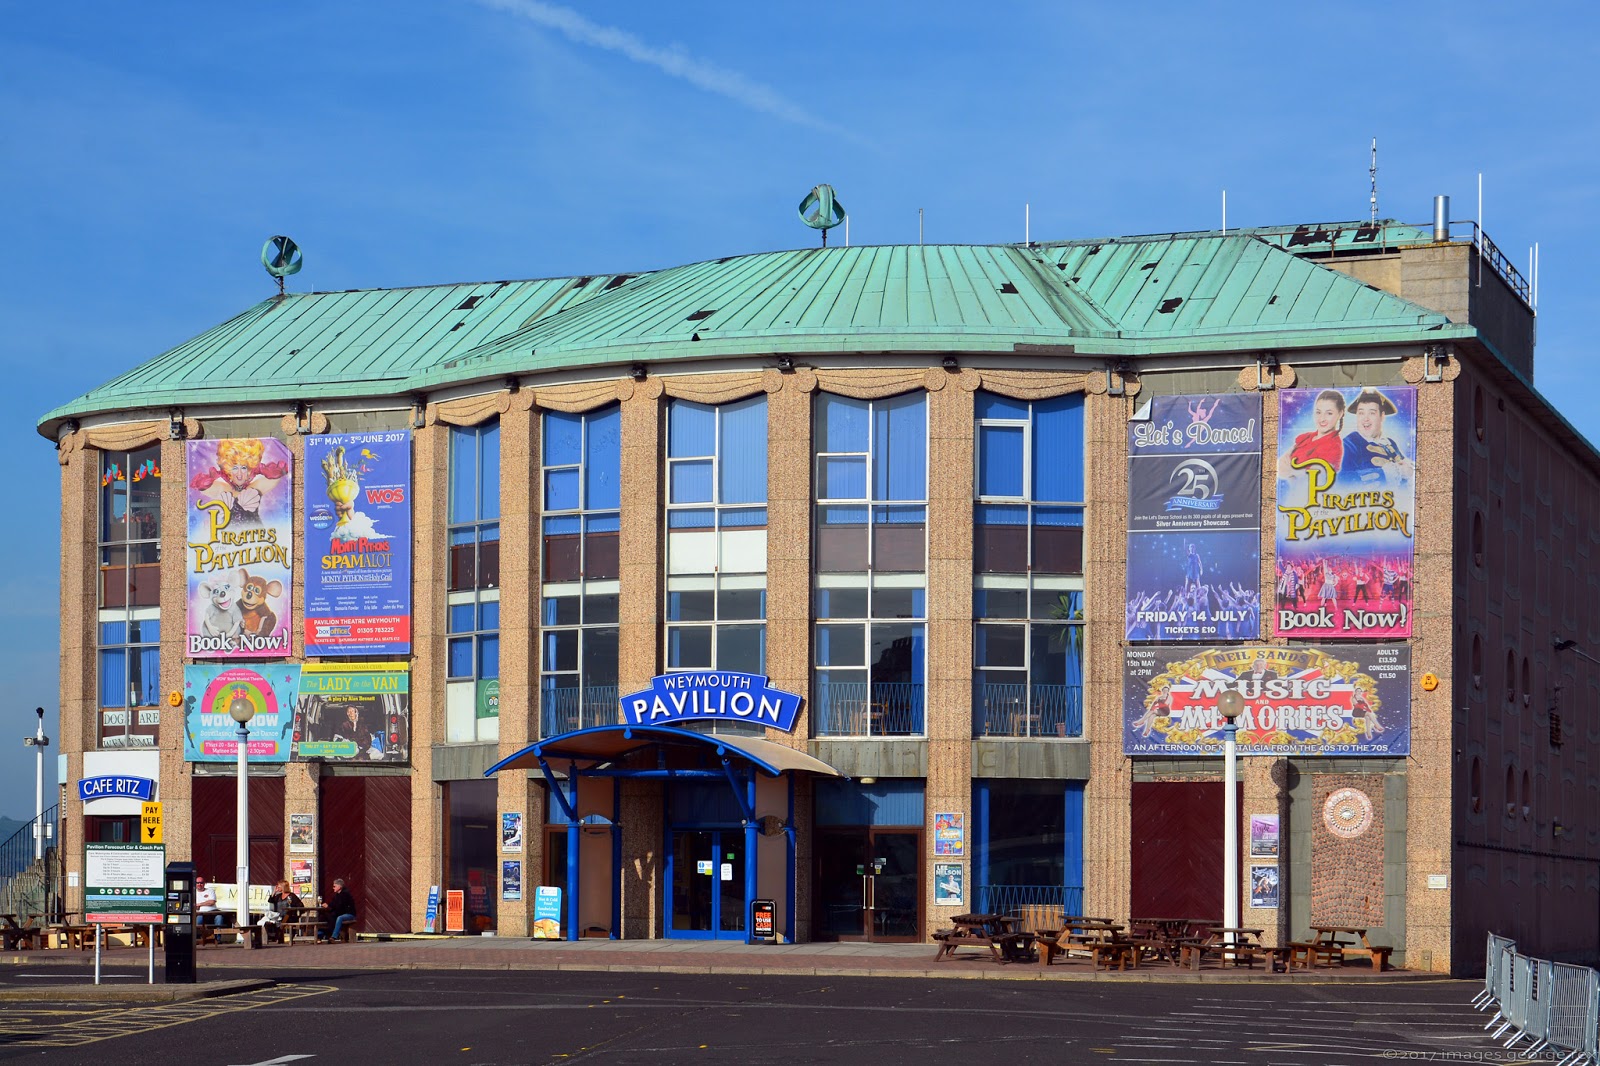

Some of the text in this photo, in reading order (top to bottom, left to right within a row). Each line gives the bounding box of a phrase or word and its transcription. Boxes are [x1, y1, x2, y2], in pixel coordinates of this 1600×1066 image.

[324, 436, 343, 445] MAY
[361, 434, 384, 444] JUNE
[385, 433, 405, 443] 2017
[1134, 420, 1182, 447] Let's
[1290, 457, 1395, 511] PIRATES
[366, 488, 405, 504] WOS
[1172, 498, 1219, 508] ANNIVERSARY
[196, 499, 277, 546] PIRATES
[1278, 505, 1412, 541] PAVILION
[330, 538, 357, 555] MONTY
[188, 541, 290, 573] PAVILION
[321, 553, 392, 570] SPAMALOT
[342, 574, 364, 582] PYTHON
[1136, 610, 1248, 622] FRIDAY 14 JULY
[1278, 603, 1407, 630] Book Now!
[1164, 626, 1216, 634] TICKETS £10
[189, 627, 289, 653] Book Now!
[1215, 650, 1310, 663] NEIL SANDS
[319, 677, 352, 691] LADY
[371, 676, 399, 690] VAN
[664, 675, 750, 690] WEYMOUTH
[1189, 679, 1331, 700] MUSIC
[632, 690, 782, 724] PAVILION
[139, 712, 159, 723] ARE
[1271, 744, 1297, 752] FROM
[1300, 744, 1317, 752] THE
[1318, 744, 1336, 752] 40S
[1337, 744, 1349, 752] TO
[1351, 744, 1369, 752] THE
[1371, 744, 1388, 752] 70S
[83, 778, 140, 795] CAFE RITZ
[145, 806, 158, 814] PAY
[142, 816, 160, 824] HERE
